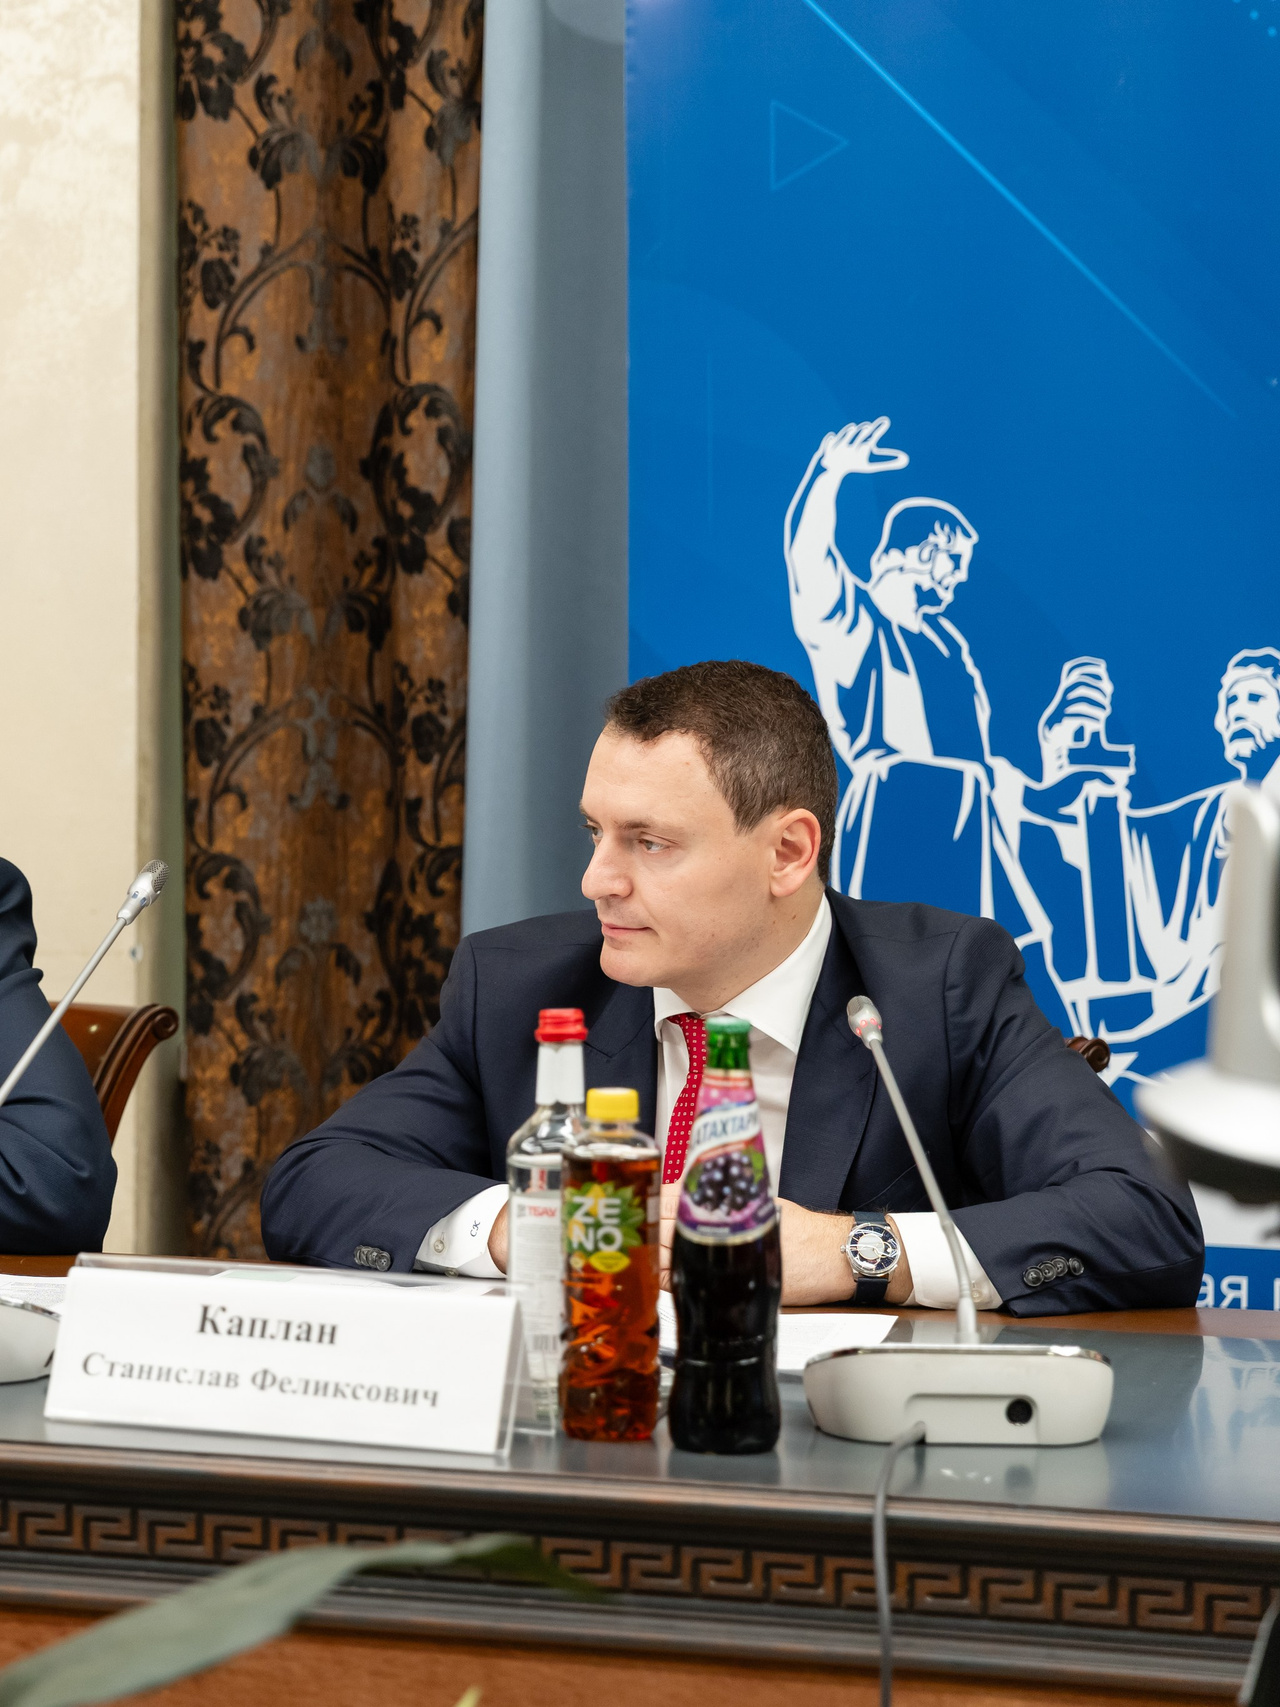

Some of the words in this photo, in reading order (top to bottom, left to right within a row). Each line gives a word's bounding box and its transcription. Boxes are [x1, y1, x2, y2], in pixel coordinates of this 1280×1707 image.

[196, 1304, 339, 1346] Каплан
[81, 1352, 239, 1389] Станислав
[250, 1368, 440, 1408] Феликсович
